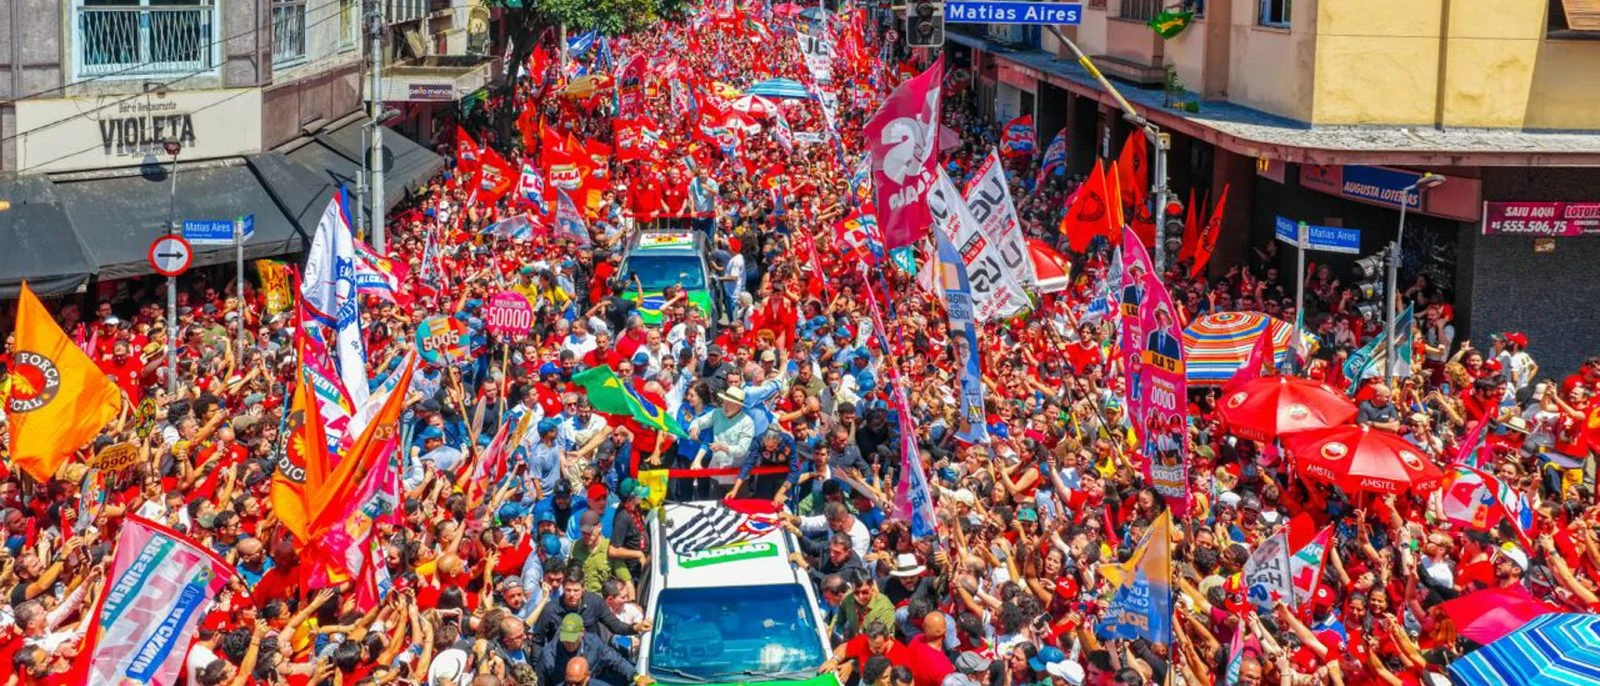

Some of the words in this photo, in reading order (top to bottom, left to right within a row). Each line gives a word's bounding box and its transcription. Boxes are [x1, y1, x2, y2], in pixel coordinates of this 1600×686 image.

[949, 4, 1017, 19] Matias
[1023, 6, 1077, 21] Aires
[98, 113, 197, 149] VIOLETA
[1343, 181, 1380, 198] AUGUSTA
[1380, 187, 1418, 205] LOTERAS
[1504, 206, 1530, 217] SAIU
[1530, 206, 1555, 218] AQUI
[185, 221, 210, 232] Matias
[212, 221, 232, 232] Aires
[1310, 227, 1335, 239] Matias
[1336, 230, 1357, 242] Aires
[1502, 220, 1568, 235] 555.506,75
[488, 306, 530, 329] 50000
[423, 330, 460, 351] 5005
[1306, 463, 1336, 481] AMSTEL
[1360, 477, 1397, 491] AMSTEL
